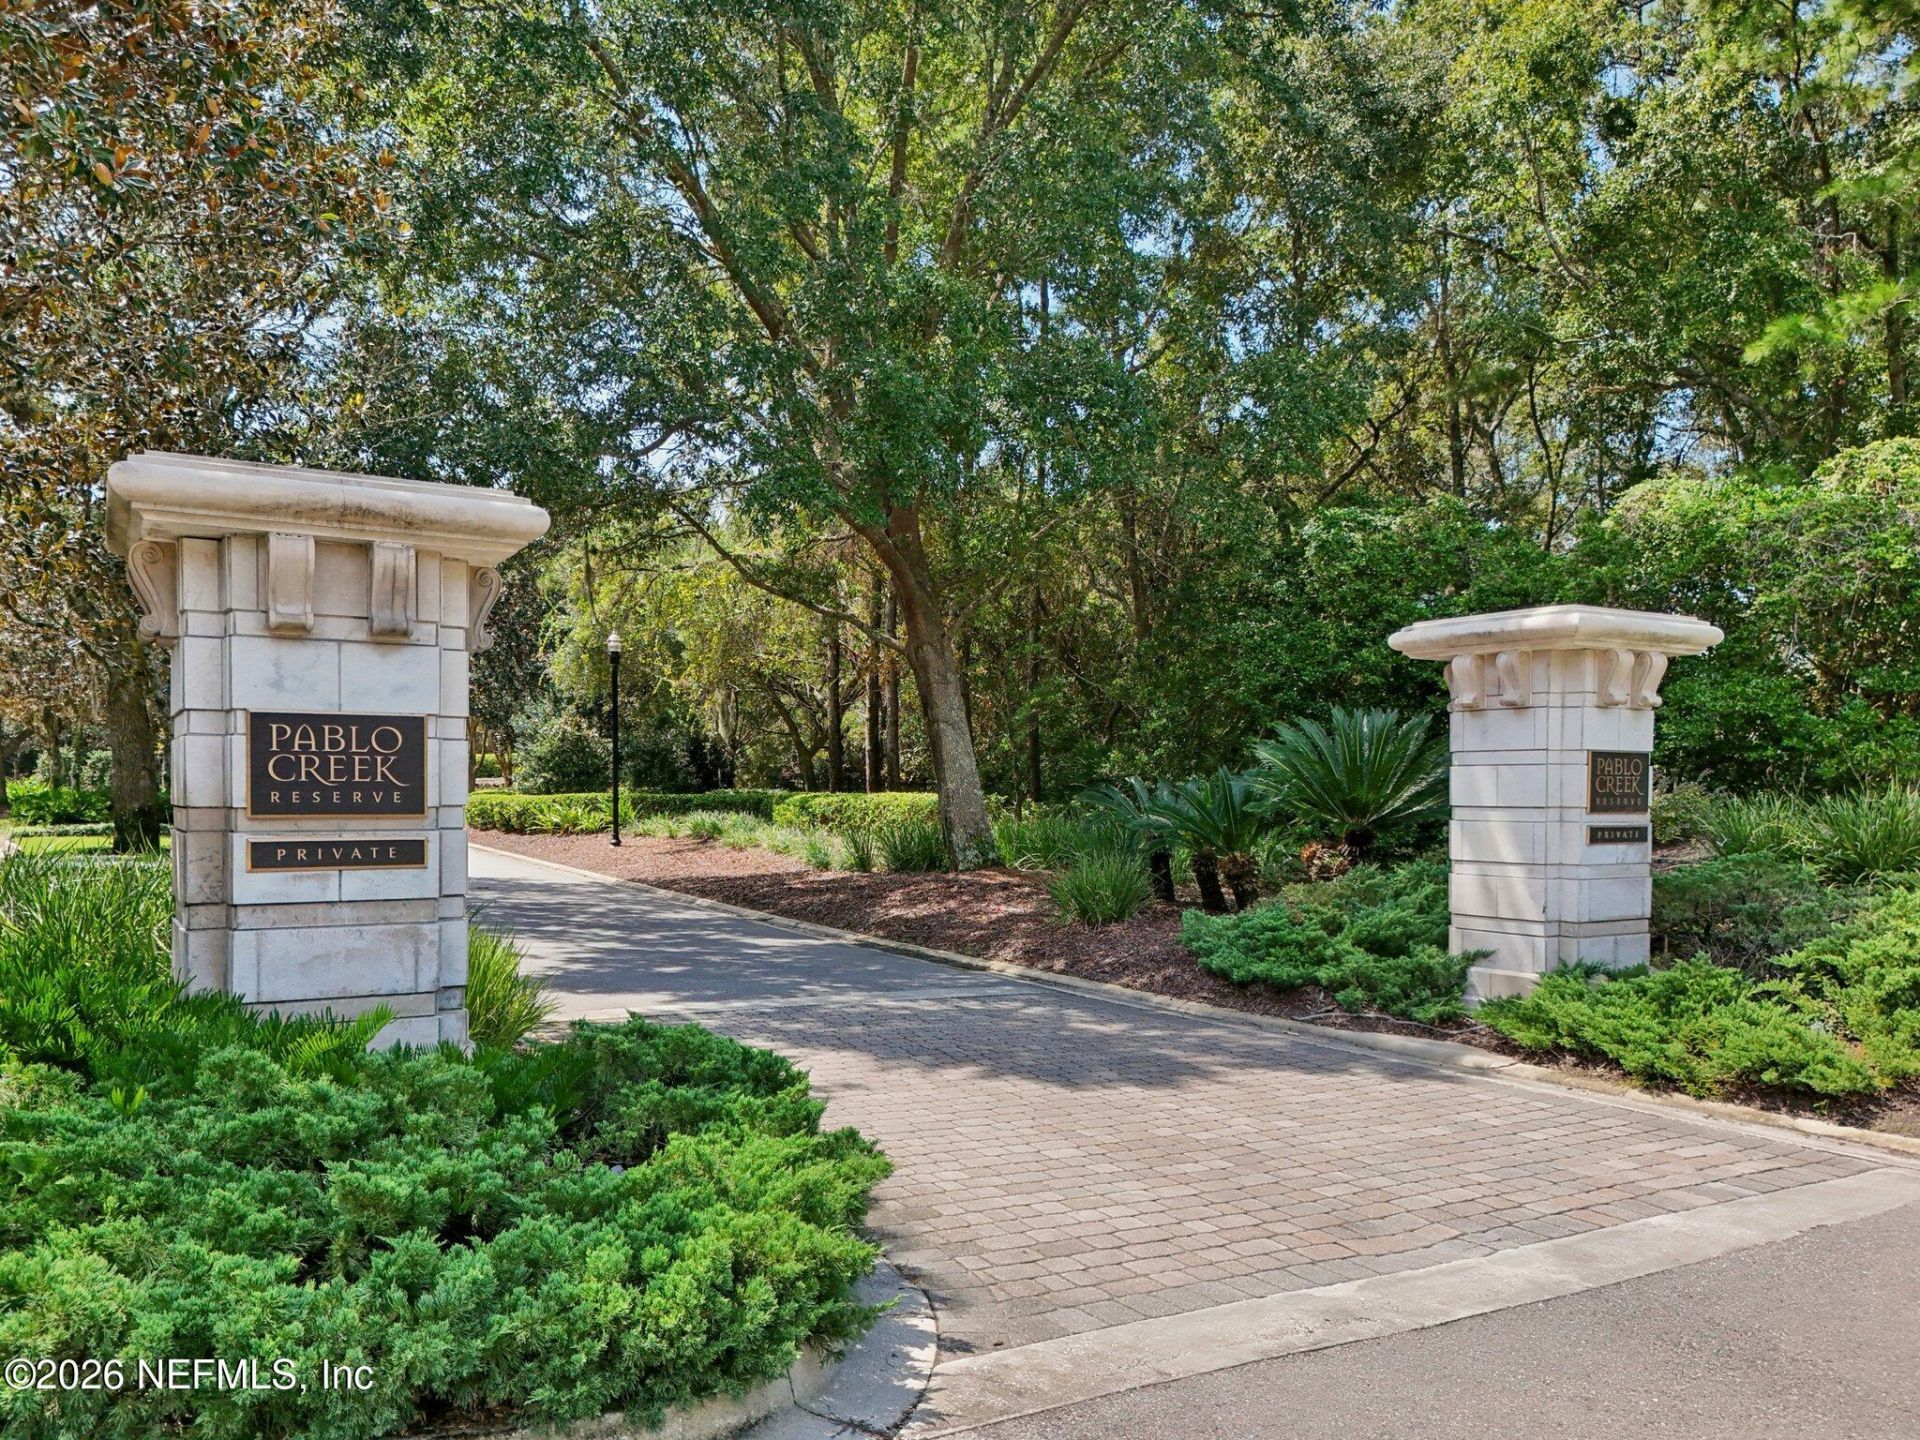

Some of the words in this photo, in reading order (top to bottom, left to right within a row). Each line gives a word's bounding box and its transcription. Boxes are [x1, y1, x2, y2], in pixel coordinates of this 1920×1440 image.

[269, 723, 403, 754] PABLO
[268, 754, 410, 787] CREEK
[1596, 758, 1643, 776] PABLO
[1595, 776, 1644, 795] CREEK
[270, 791, 402, 803] RESERVE
[1597, 830, 1640, 839] PRIVATE
[277, 847, 397, 861] PRIVATE
